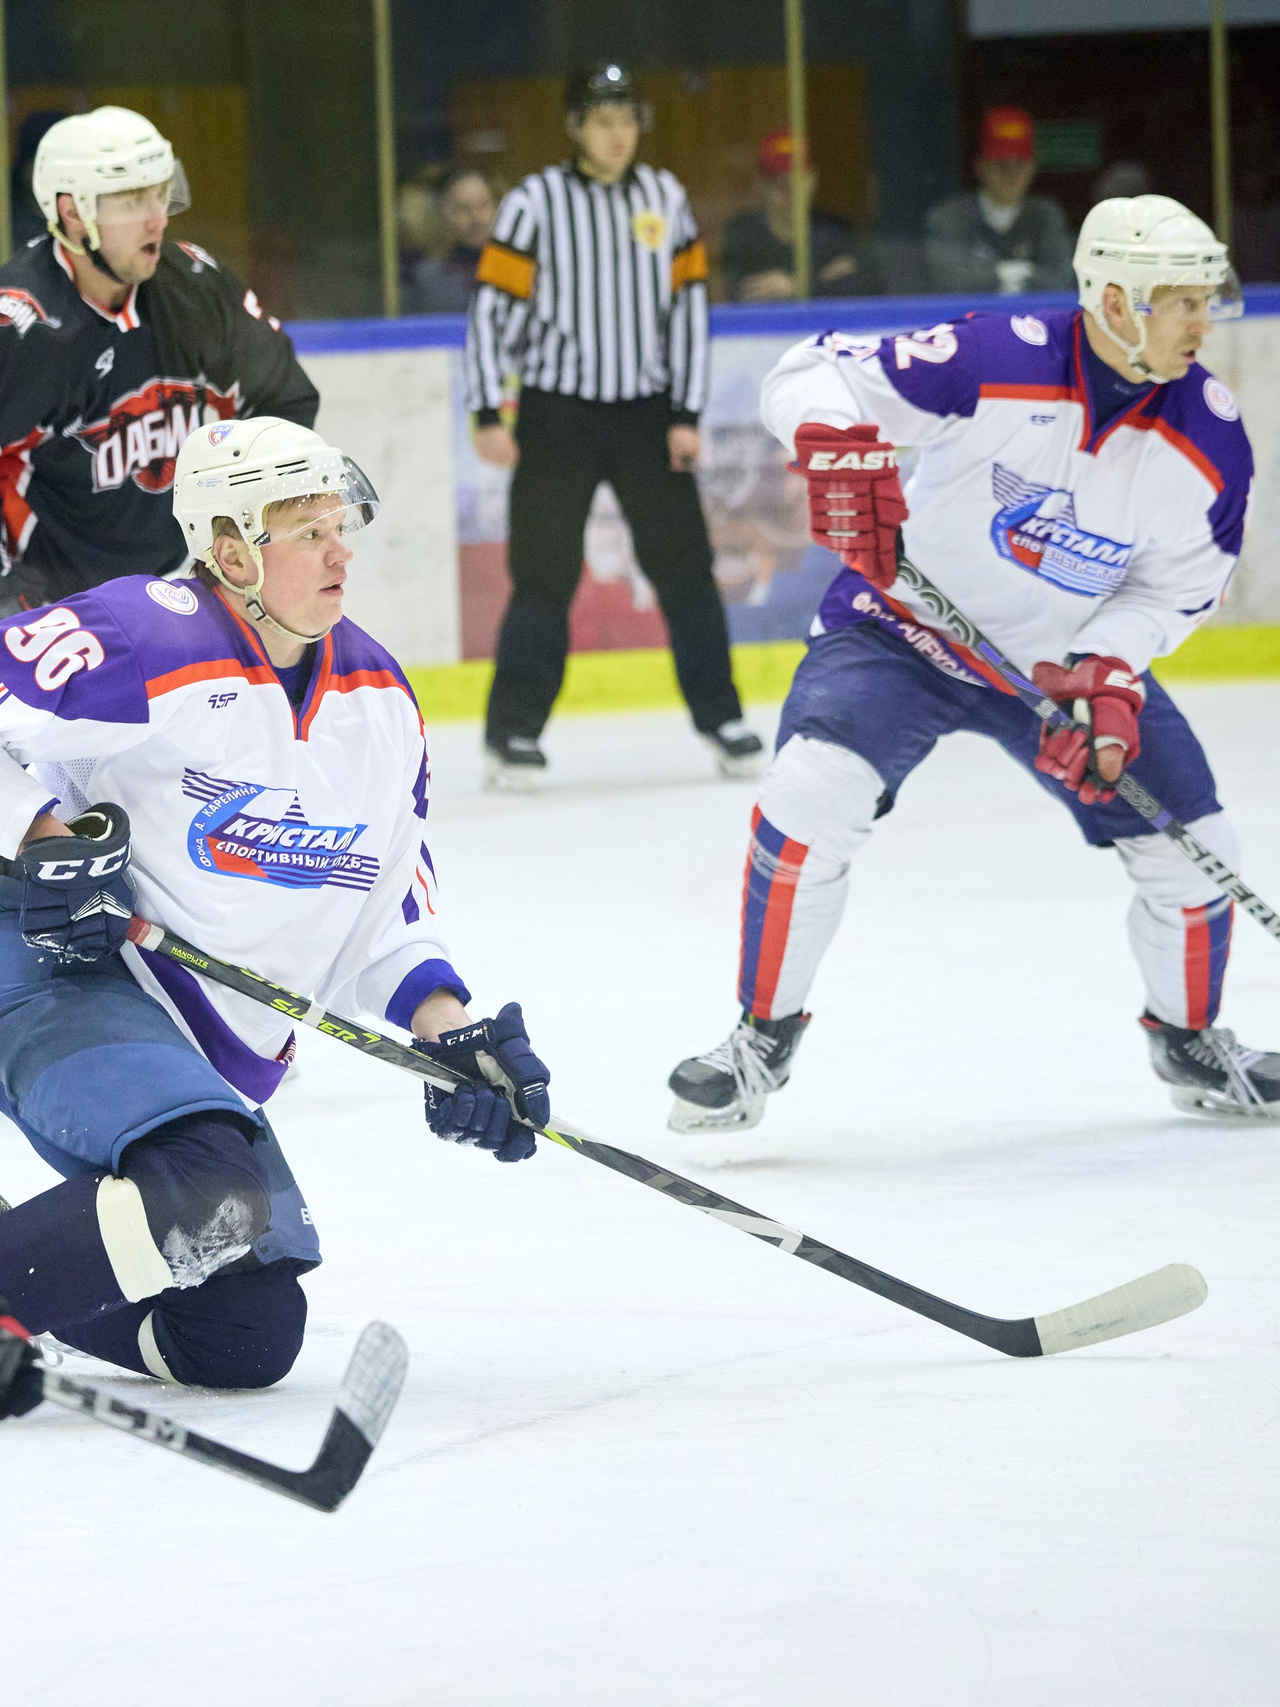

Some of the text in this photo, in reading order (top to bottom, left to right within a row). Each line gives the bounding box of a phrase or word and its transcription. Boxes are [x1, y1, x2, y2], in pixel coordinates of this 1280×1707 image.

[4, 606, 106, 692] 96
[201, 786, 259, 818] КАРЕЛИНА
[271, 998, 358, 1043] SUER
[446, 1029, 483, 1047] CCM
